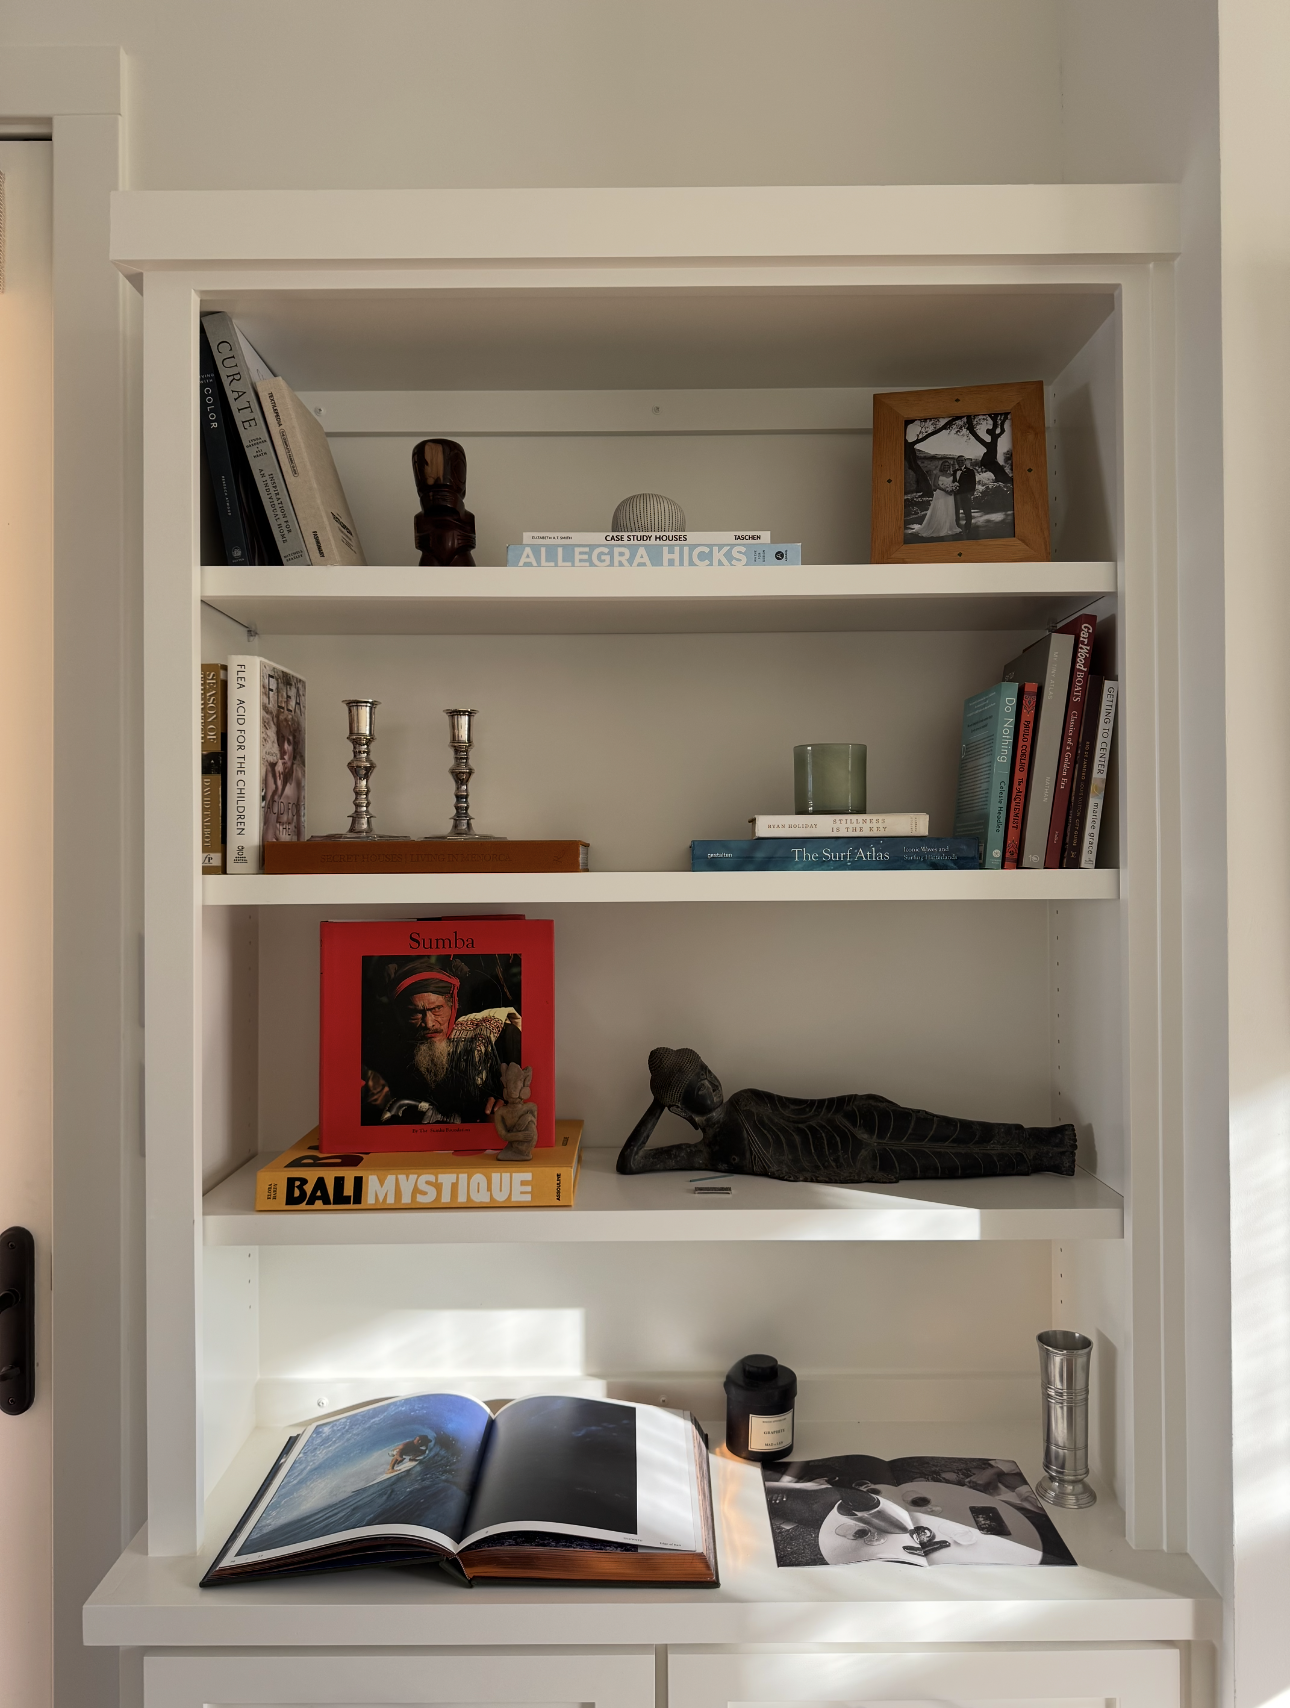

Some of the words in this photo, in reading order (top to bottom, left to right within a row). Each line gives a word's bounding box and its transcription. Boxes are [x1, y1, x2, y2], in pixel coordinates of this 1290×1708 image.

[217, 341, 257, 430] CURATE
[204, 387, 218, 429] COLOR
[258, 468, 266, 478] AN
[262, 479, 281, 522] INDIVIDUAL
[276, 522, 288, 544] HOME
[268, 473, 288, 519] INSPIRATION
[283, 520, 293, 534] FOR
[604, 534, 625, 542] CASE
[626, 534, 653, 542] STUDY
[655, 534, 688, 542] HOUSES
[518, 546, 652, 567] ALLEGRA
[662, 546, 748, 567] HICKS
[1080, 623, 1093, 644] Gar
[1076, 643, 1091, 671] Wood
[236, 664, 246, 690] FLEA
[1050, 663, 1058, 678] TINY
[206, 671, 217, 722] SEASON
[267, 673, 303, 717] FLEA
[1047, 679, 1055, 700] ATLAS
[1073, 671, 1085, 702] BOATS
[236, 698, 246, 726] ACID
[1004, 697, 1016, 713] Do
[1103, 686, 1115, 725] GETTING
[206, 724, 217, 744] OF
[1021, 720, 1031, 743] PAULO
[1068, 710, 1078, 736] Classics
[1101, 728, 1110, 739] TO
[236, 729, 246, 751] FOR
[996, 717, 1014, 763] Nothing
[1066, 737, 1074, 746] of
[236, 754, 246, 776] THE
[1062, 752, 1072, 776] Golden
[1096, 741, 1108, 775] CENTER
[203, 778, 211, 808] DAVID
[1060, 777, 1068, 789] Era
[236, 779, 246, 836] CHILDREN
[1090, 802, 1099, 830] marlee
[203, 809, 211, 847] TALBOT
[791, 847, 819, 862] The
[822, 847, 853, 862] Surf
[854, 846, 890, 862] Atlas
[1087, 832, 1095, 855] grace
[320, 854, 359, 863] SECRET
[361, 853, 403, 863] HOUSES
[409, 853, 446, 863] LIVING
[447, 853, 459, 863] IN
[460, 853, 513, 863] MENORCA
[408, 931, 476, 950] Sumba
[285, 1175, 364, 1206] BALI
[367, 1172, 533, 1205] MYSTIQUE
